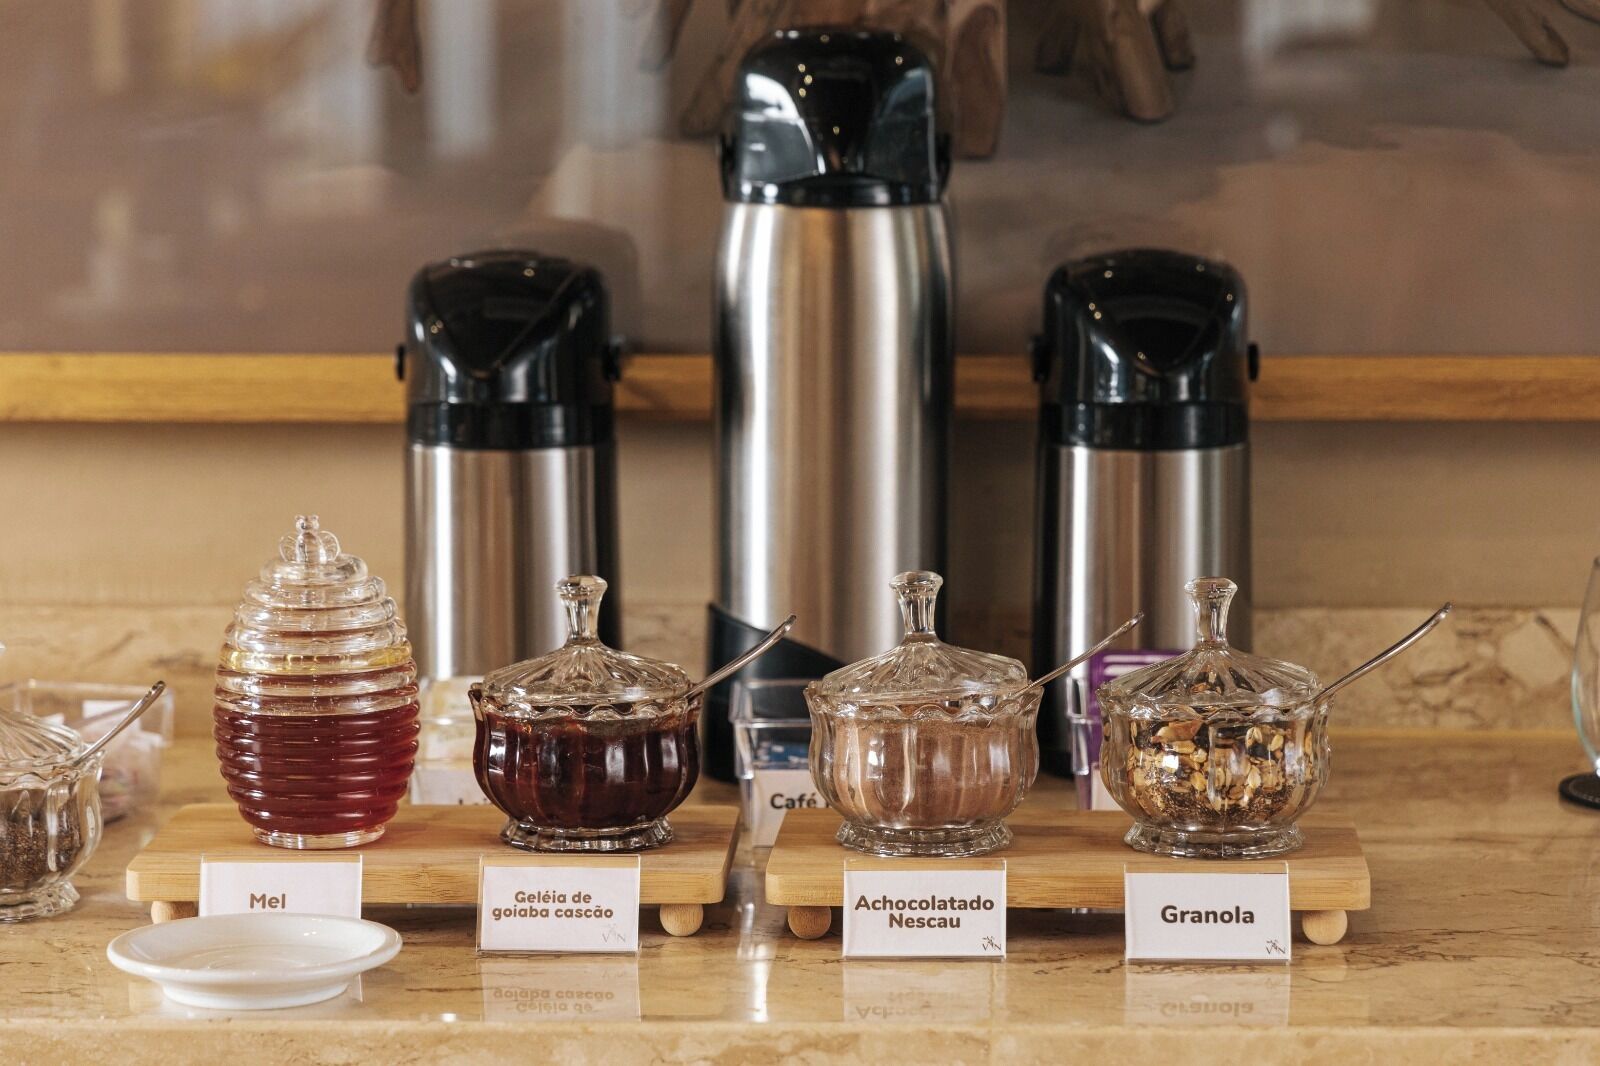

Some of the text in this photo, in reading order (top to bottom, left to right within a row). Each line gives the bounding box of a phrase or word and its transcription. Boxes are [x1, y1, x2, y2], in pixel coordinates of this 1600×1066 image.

[770, 793, 817, 809] Café
[250, 893, 286, 909] Mel
[514, 890, 592, 904] Geléia de
[854, 895, 995, 911] Achocolatado
[492, 904, 614, 921] goiaba cascão
[888, 913, 961, 928] Nescau
[1160, 905, 1255, 924] Granola
